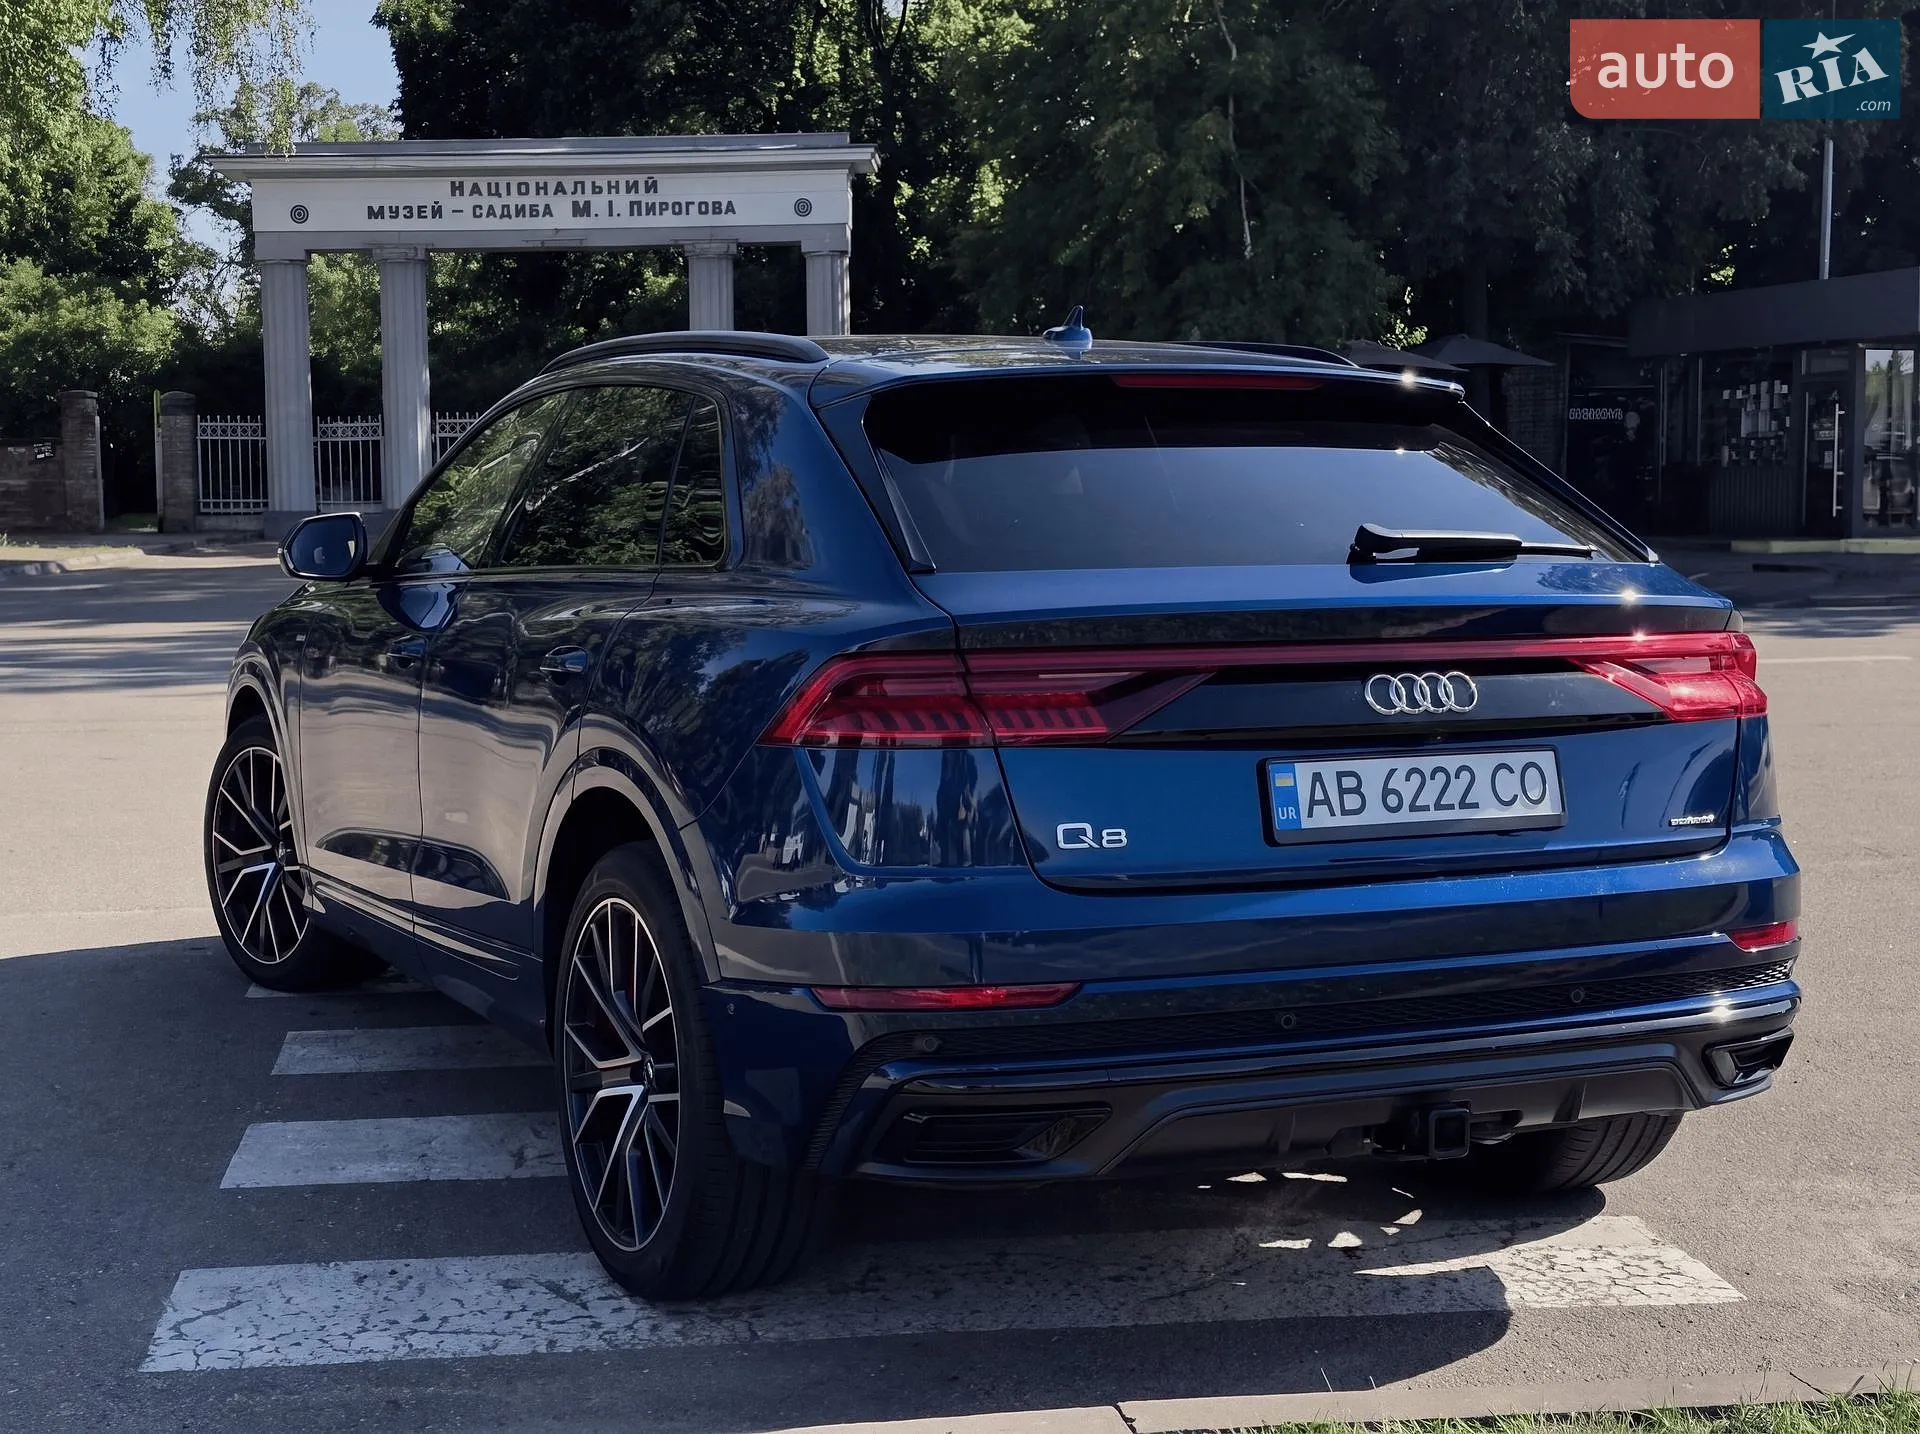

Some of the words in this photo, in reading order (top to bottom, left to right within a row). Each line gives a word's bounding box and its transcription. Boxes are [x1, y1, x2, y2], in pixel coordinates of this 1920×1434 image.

[450, 176, 659, 198] НАЦІОНАЛЬНИЙ
[367, 201, 444, 220] МУЗЕЙ
[472, 203, 554, 220] САДИБА
[629, 200, 737, 217] ПИРОГОВА
[1307, 770, 1367, 819] AB
[1381, 764, 1480, 814] 6222
[1490, 761, 1547, 807] CO
[1056, 822, 1128, 849] Q8
